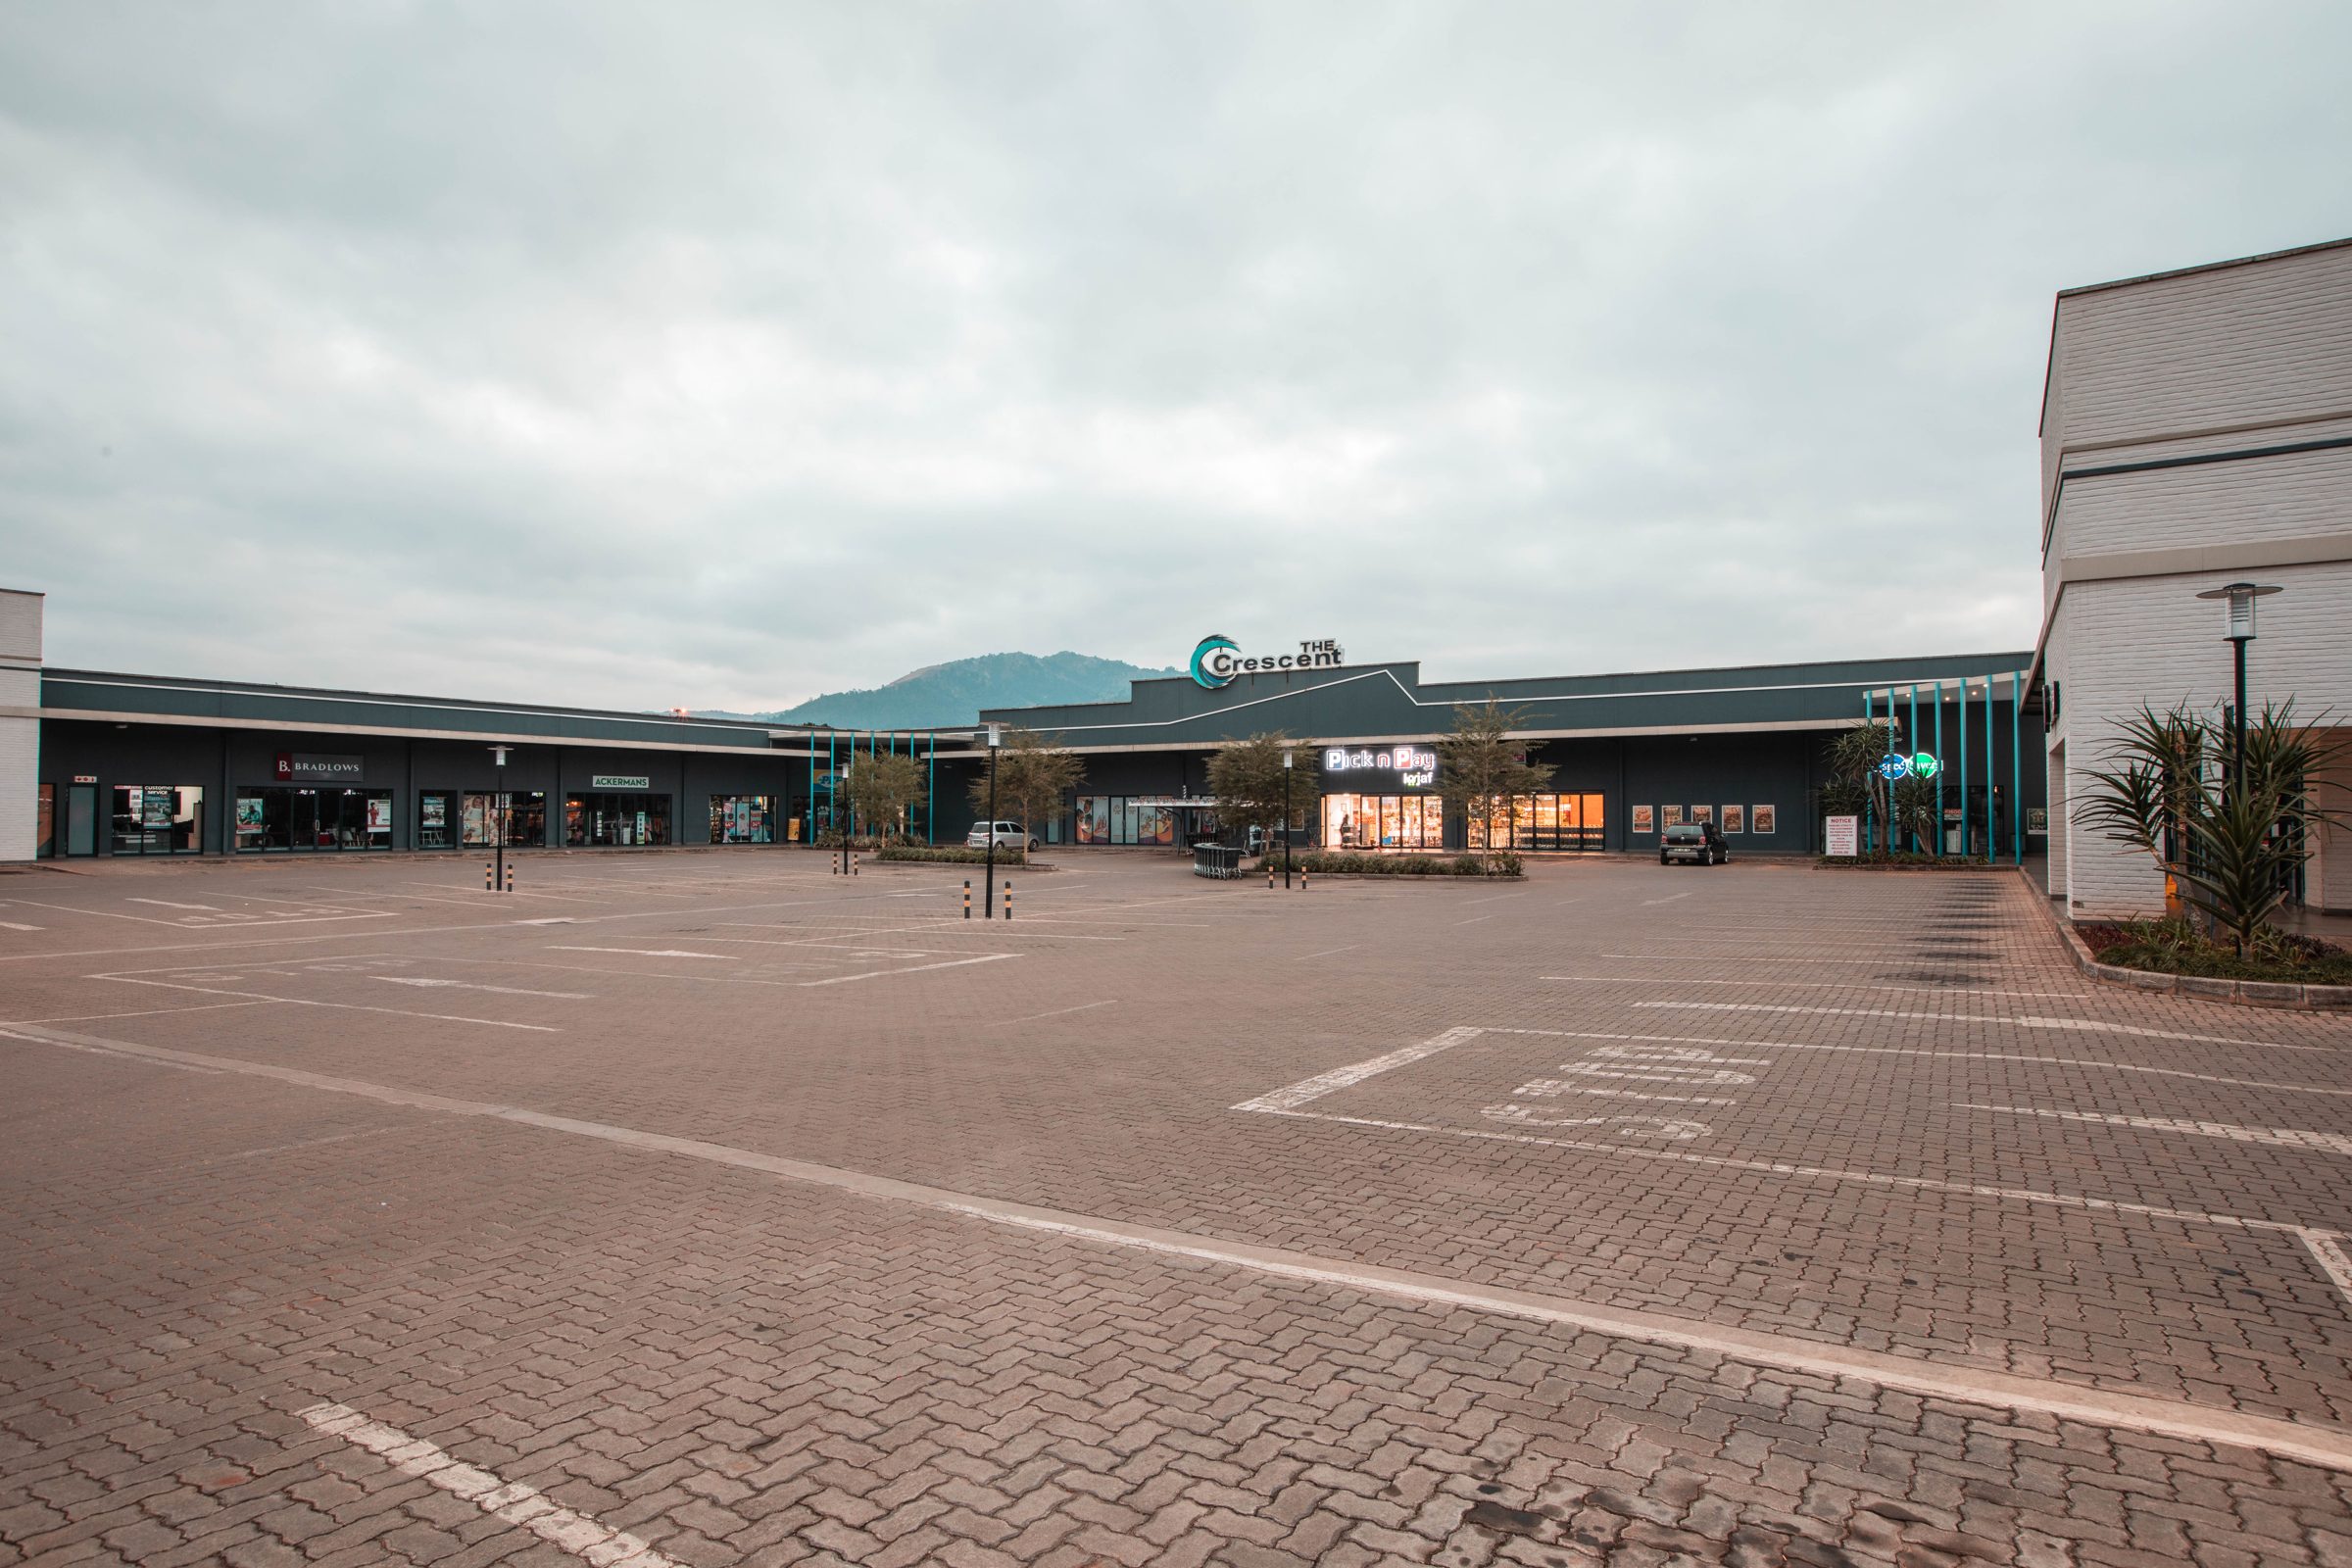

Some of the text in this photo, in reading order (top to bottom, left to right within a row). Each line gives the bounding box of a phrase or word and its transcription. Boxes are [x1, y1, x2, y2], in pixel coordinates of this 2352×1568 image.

[1300, 640, 1335, 653] THE
[1213, 648, 1342, 673] Crescent
[1327, 749, 1435, 771] Pick n Pay
[295, 762, 360, 772] BRADLOWS
[595, 777, 647, 787] ACKERMANS
